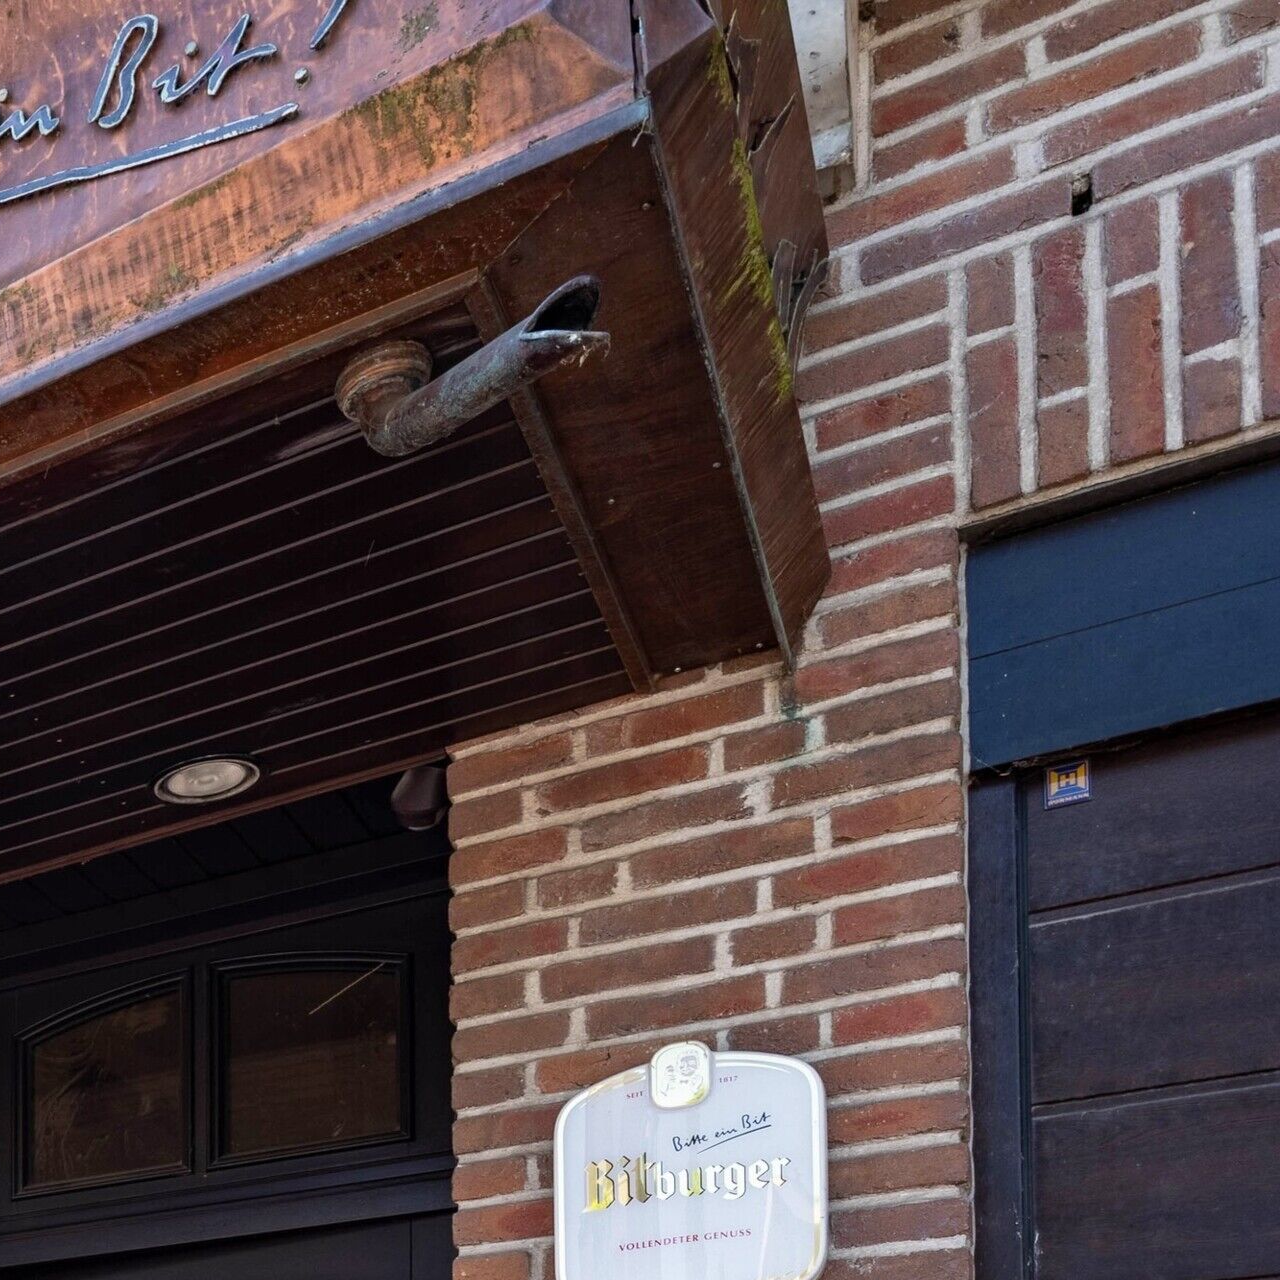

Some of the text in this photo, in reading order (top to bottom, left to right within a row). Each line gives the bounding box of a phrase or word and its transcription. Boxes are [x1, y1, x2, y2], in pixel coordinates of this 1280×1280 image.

[672, 1112, 772, 1152] Bitte ein Bit
[581, 1152, 792, 1213] Bitburger
[619, 1228, 753, 1252] VOLLENDETER GENUSS
